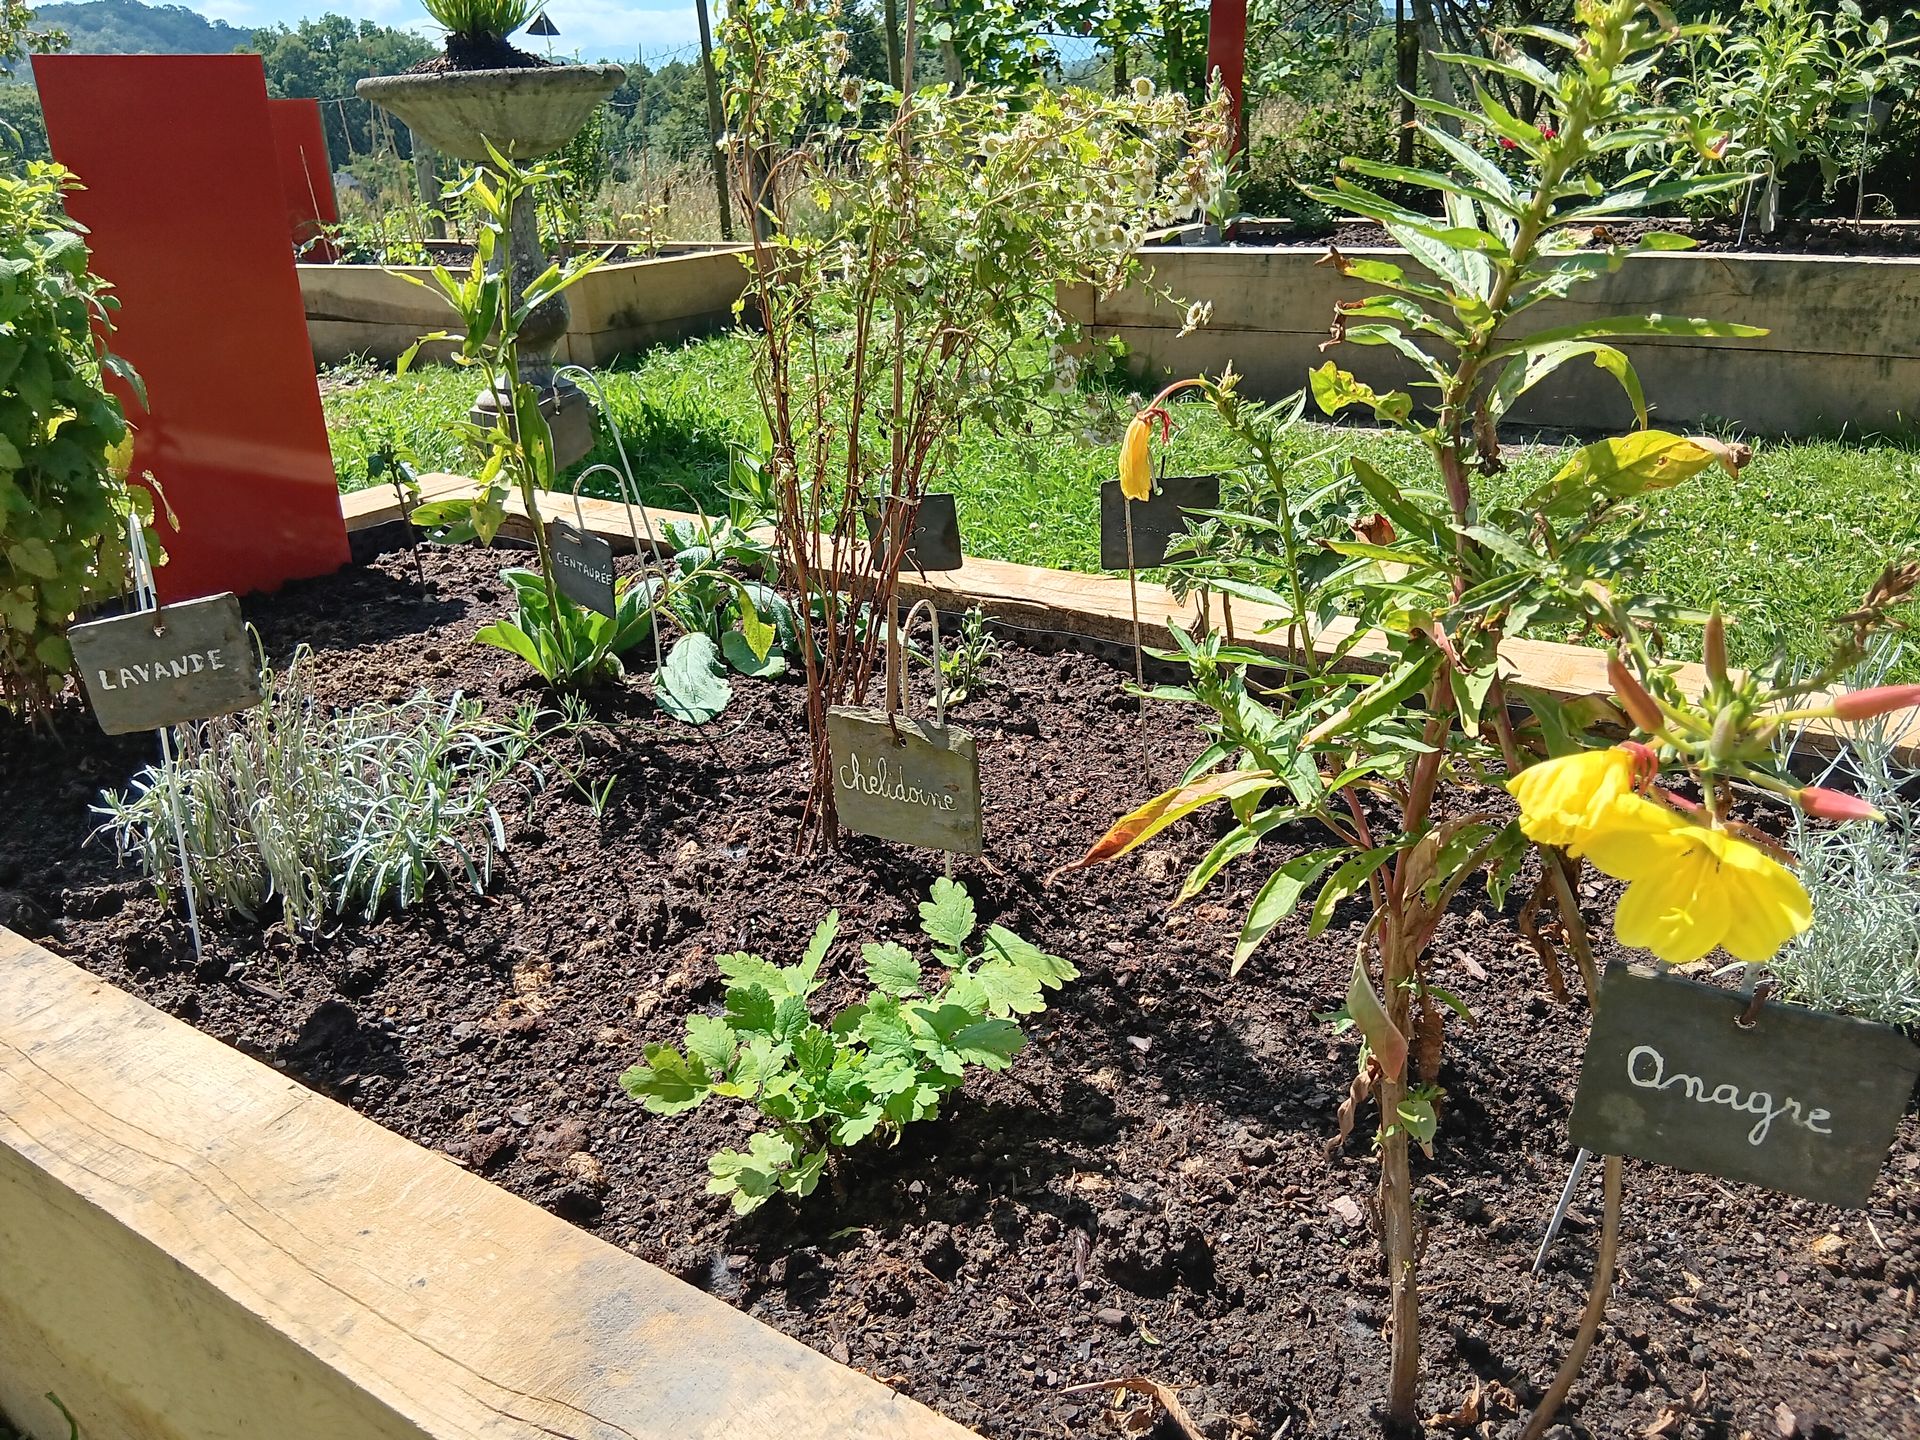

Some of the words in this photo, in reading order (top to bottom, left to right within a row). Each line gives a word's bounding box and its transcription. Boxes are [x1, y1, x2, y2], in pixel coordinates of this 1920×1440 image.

[556, 552, 613, 585] CENTAURÉE
[98, 648, 226, 690] LAVANDE
[1627, 1045, 1833, 1146] Onagre
